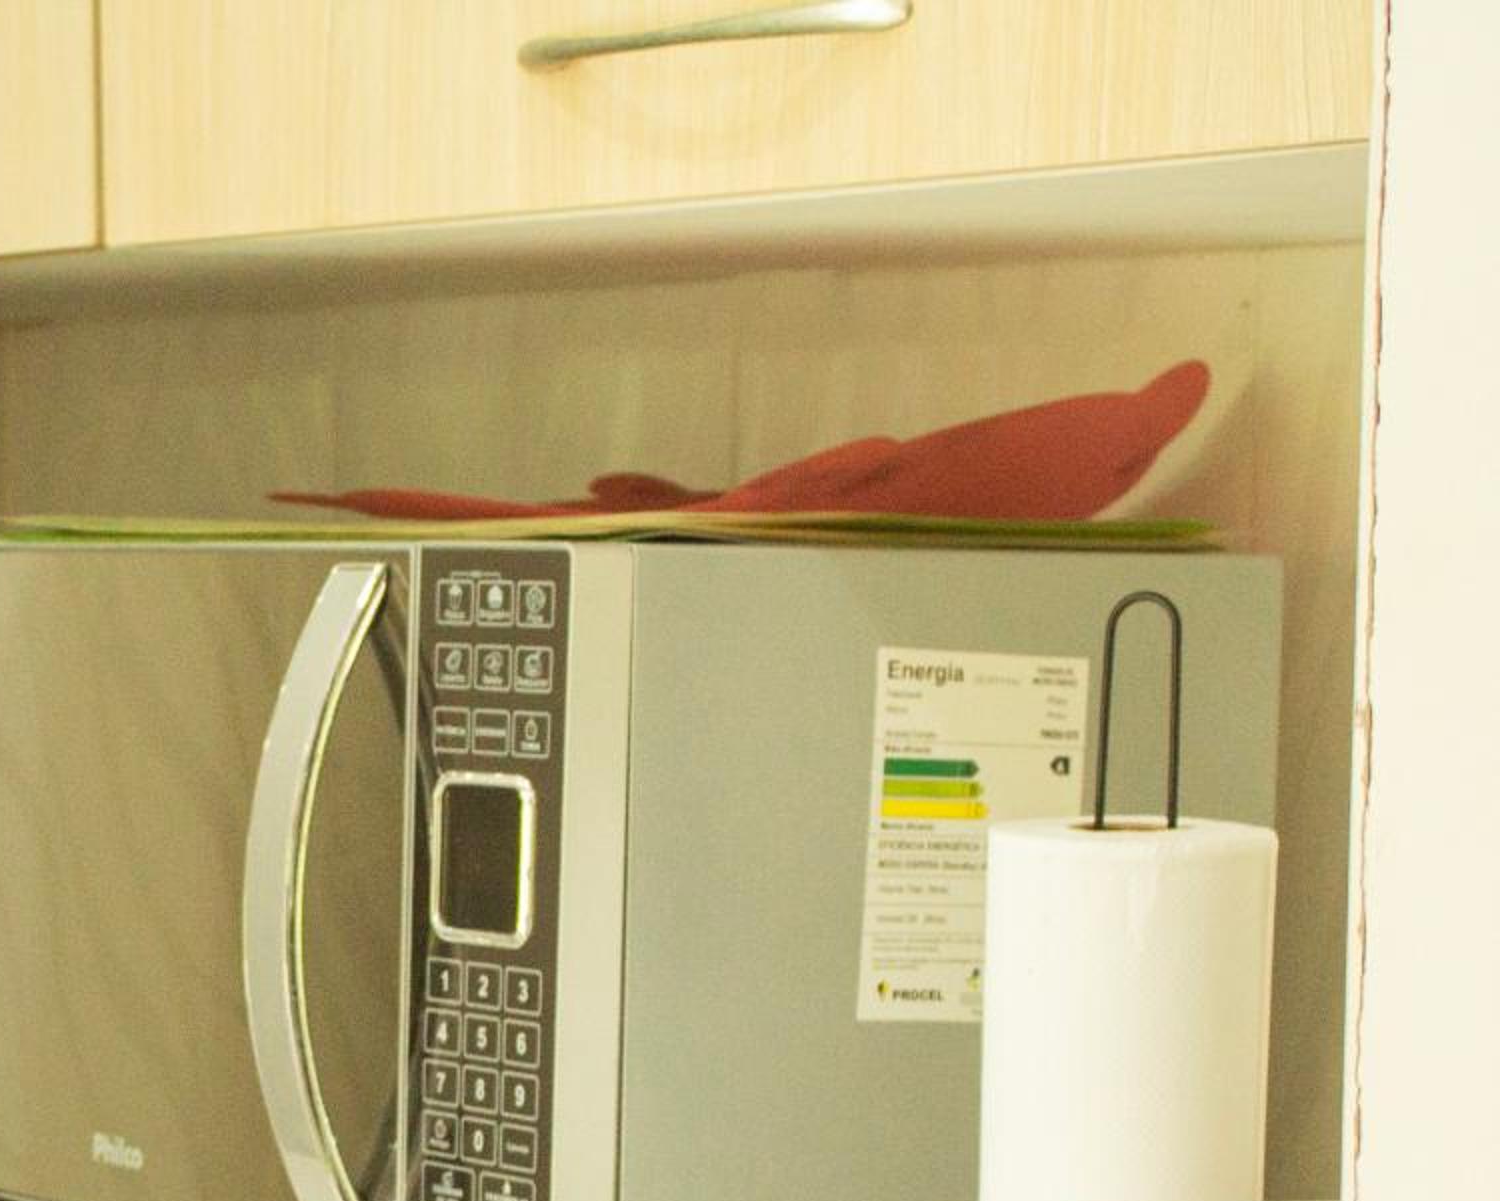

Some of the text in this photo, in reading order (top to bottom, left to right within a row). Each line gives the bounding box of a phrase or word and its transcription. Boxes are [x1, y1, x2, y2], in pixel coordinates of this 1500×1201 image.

[887, 659, 965, 687] Energia
[440, 969, 449, 992] 1
[478, 974, 489, 998] 2
[517, 979, 529, 1003] 3
[436, 1021, 448, 1044] 4
[476, 1026, 487, 1049] 5
[515, 1031, 527, 1055] 6
[435, 1071, 446, 1094] 7
[475, 1078, 485, 1102] 8
[514, 1084, 525, 1108] 9
[473, 1129, 484, 1152] 0
